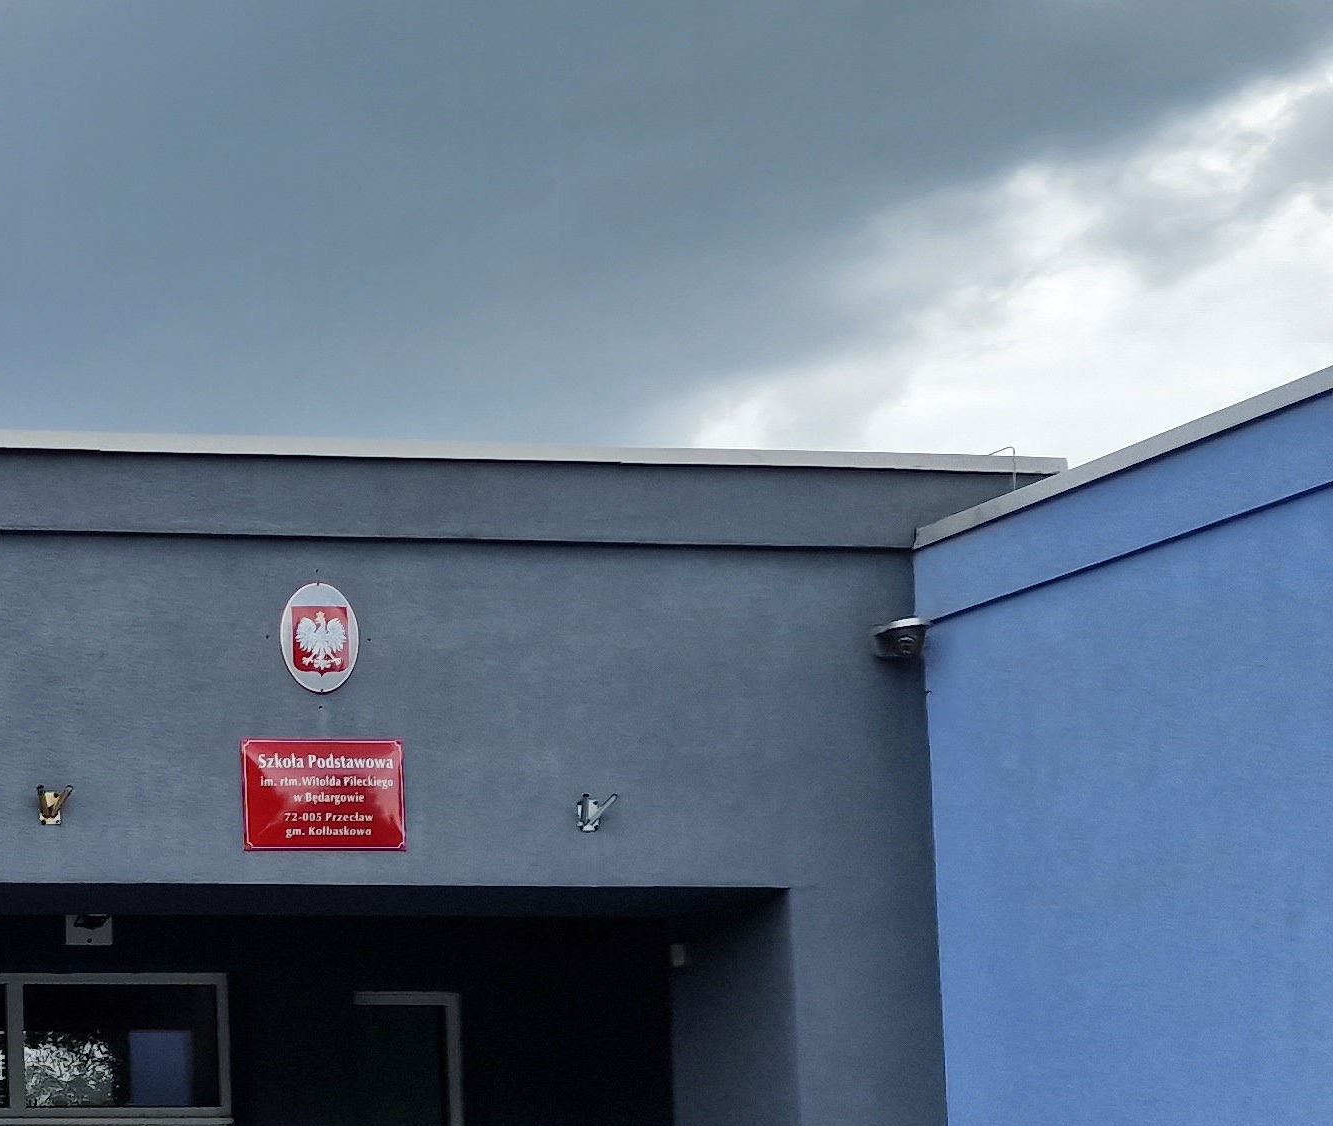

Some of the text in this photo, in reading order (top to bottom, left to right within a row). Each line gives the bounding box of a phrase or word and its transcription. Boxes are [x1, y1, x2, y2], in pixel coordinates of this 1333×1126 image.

[258, 753, 394, 769] Szkoła Podstawowa
[343, 776, 393, 789] Pileckiego
[293, 792, 365, 805] w Będargowie
[284, 812, 322, 822] 72-005
[285, 828, 305, 838] gm.
